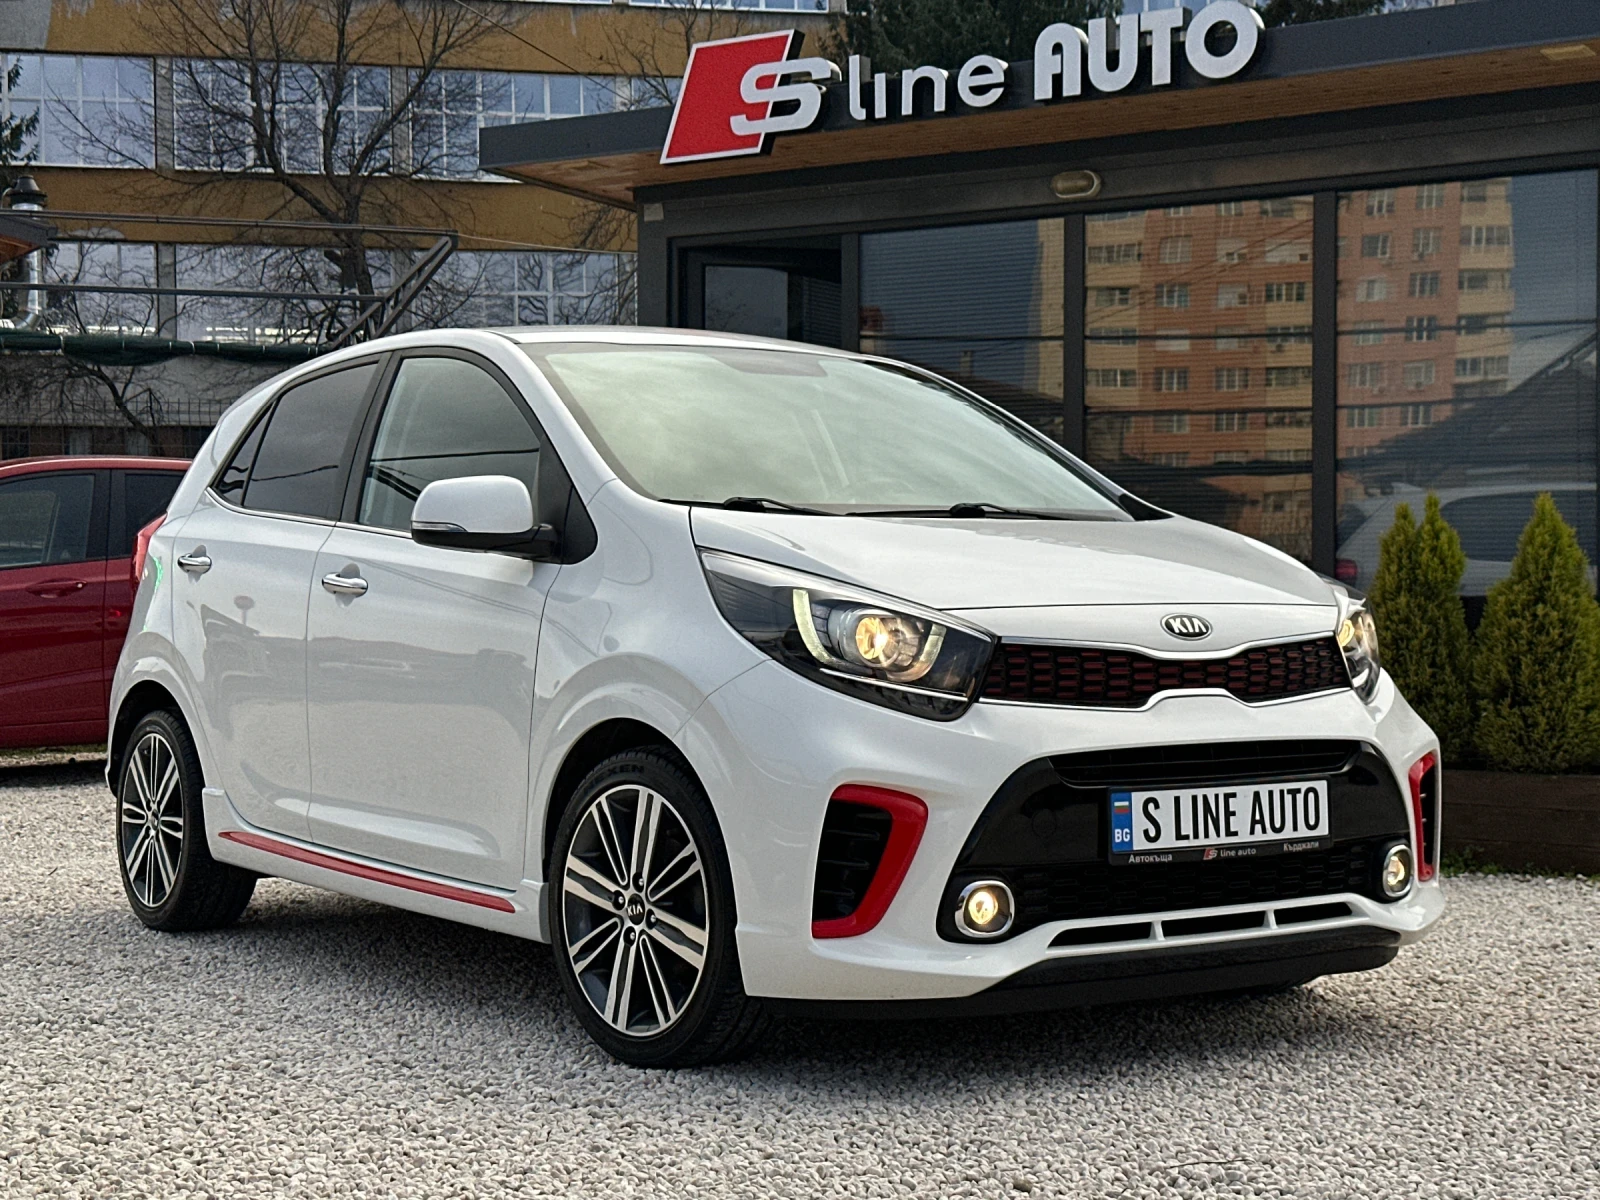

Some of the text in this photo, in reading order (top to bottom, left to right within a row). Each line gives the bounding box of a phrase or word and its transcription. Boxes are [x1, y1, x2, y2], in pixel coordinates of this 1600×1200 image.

[730, 57, 832, 136] S
[1034, 0, 1259, 100] AUTO
[1168, 617, 1207, 633] KIA
[1142, 786, 1320, 843] S LINE AUTO
[1114, 828, 1131, 843] BG
[1128, 853, 1173, 865] Автокъща
[1220, 848, 1236, 857] line
[1237, 847, 1257, 855] auto
[627, 903, 643, 916] KIA
